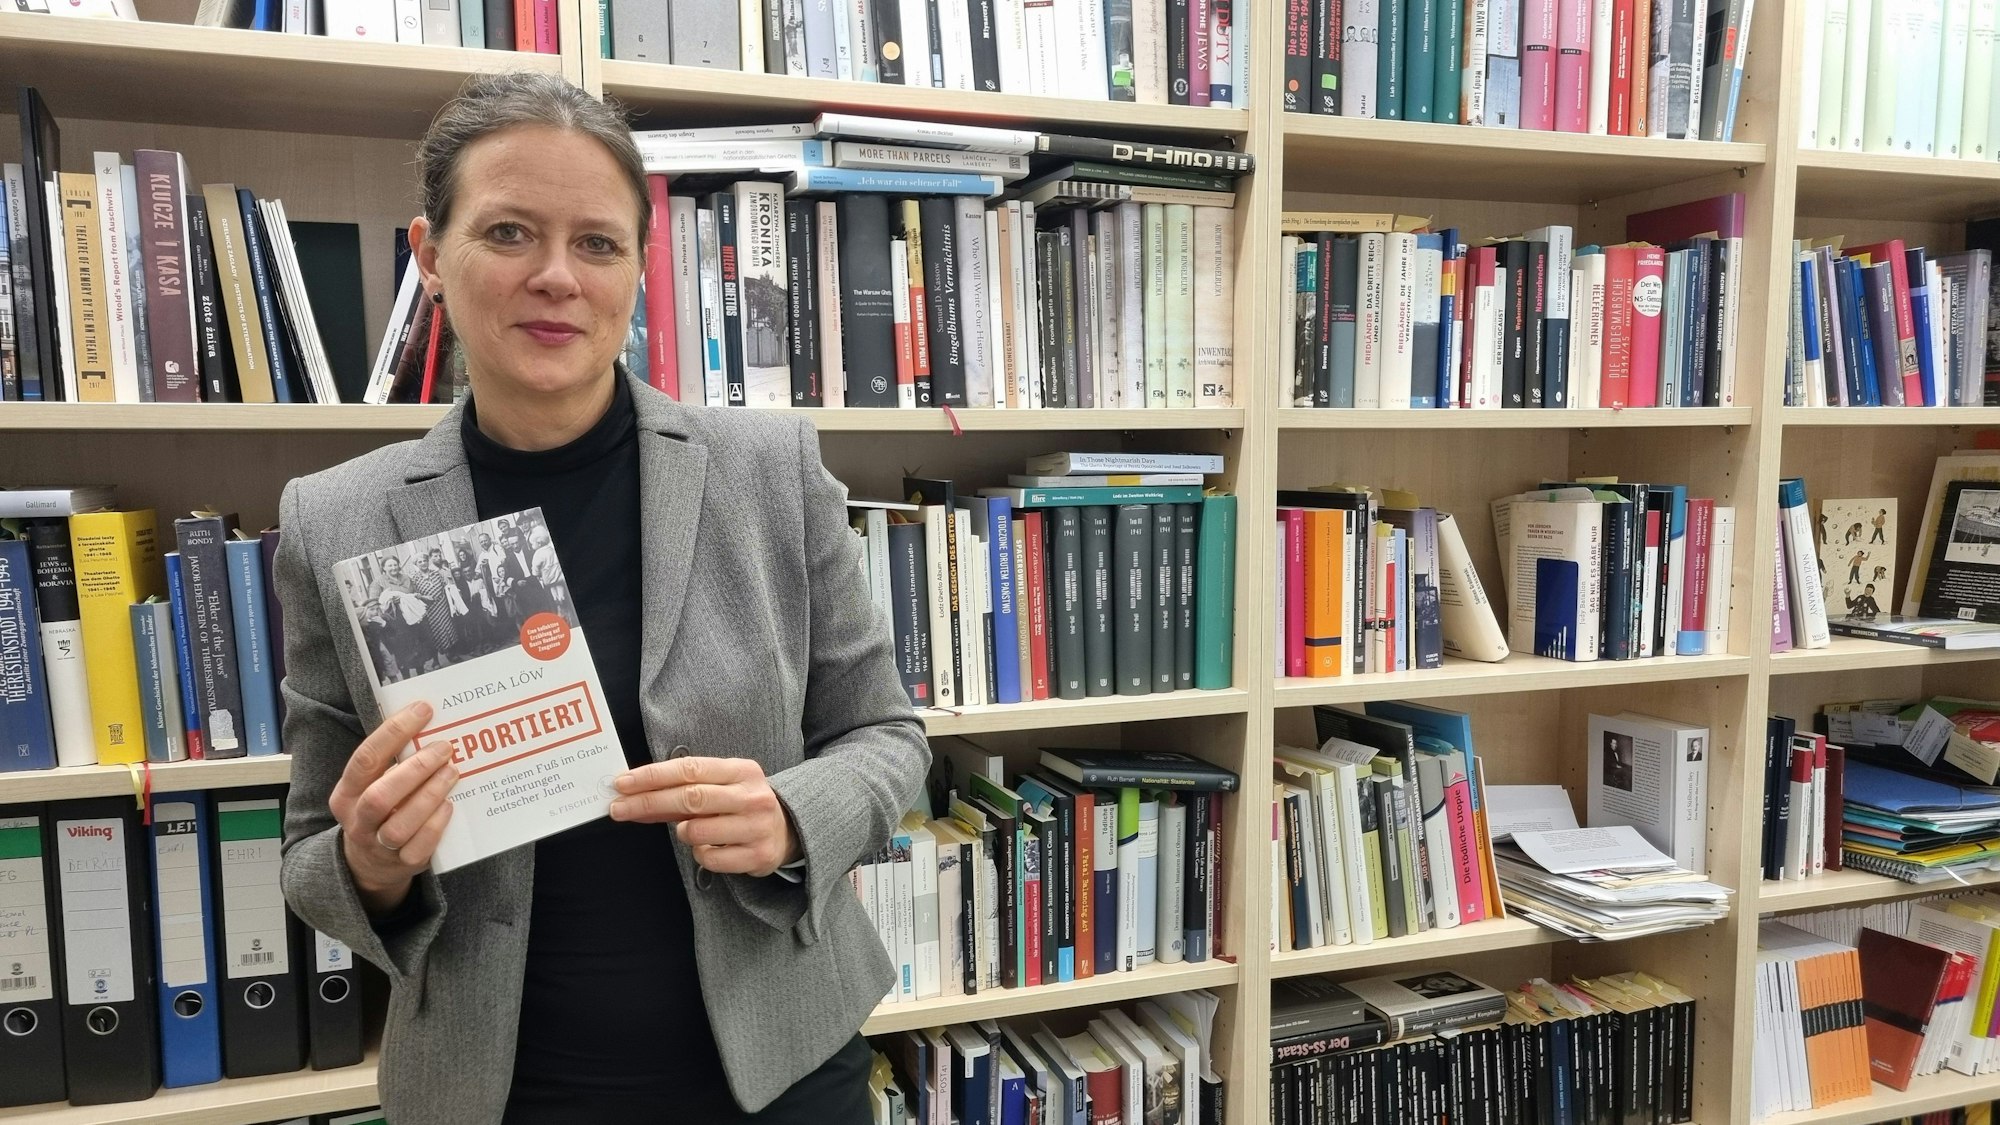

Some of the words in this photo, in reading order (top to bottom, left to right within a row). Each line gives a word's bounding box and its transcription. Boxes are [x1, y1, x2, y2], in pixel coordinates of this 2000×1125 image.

[1195, 31, 1208, 70] JEWS
[1287, 39, 1297, 55] Die
[1299, 19, 1308, 56] UdSSR«
[1693, 75, 1701, 104] Notizen
[859, 148, 884, 159] MORE
[886, 149, 911, 161] THAN
[913, 153, 951, 164] PARCELS
[910, 178, 941, 187] seltener
[105, 188, 116, 233] Auschwitz
[149, 173, 175, 230] KLUCZE
[749, 191, 758, 243] ZAMORDOWANEGO
[759, 191, 772, 268] KRONIKA
[75, 225, 87, 249] THEATRE
[110, 235, 118, 255] from
[971, 237, 979, 255] Who
[112, 257, 122, 286] Report
[722, 245, 736, 280] HITLER'S
[792, 257, 800, 280] JEWISH
[941, 224, 954, 294] Vermächtnis
[973, 259, 981, 275] Will
[79, 267, 90, 288] MEMORY
[156, 256, 181, 297] KASA
[932, 262, 941, 292] Kassow
[113, 288, 124, 322] Witold's
[221, 218, 232, 249] DZIELNICE
[234, 283, 245, 313] DISTRICTS
[241, 323, 255, 370] EXTERMINATION
[724, 282, 738, 316] GHETTOS
[793, 282, 801, 318] CHILDHOOD
[915, 294, 925, 321] WARSAW
[973, 280, 982, 307] Write
[201, 295, 215, 323] złote
[935, 306, 944, 333] Samuel
[975, 310, 984, 328] Our
[1590, 284, 1600, 346] HELFERINNEN
[1611, 278, 1624, 355] TODESMÄRSCHE
[206, 326, 217, 357] żniwa
[794, 327, 804, 355] KRAKÓW
[917, 322, 926, 346] GHETTO
[946, 298, 959, 366] Ringelblums
[1364, 313, 1372, 365] FRIEDLÄNDER
[1398, 301, 1406, 354] FRIEDLÄNDER
[85, 336, 97, 363] THEATRE
[919, 348, 927, 368] POLICE
[976, 330, 986, 368] History?
[1609, 362, 1621, 378] DIE
[25, 501, 57, 509] Gallimard
[948, 514, 956, 544] GETTOS
[996, 515, 1010, 550] OTOCZONE
[949, 546, 957, 560] DES
[998, 552, 1011, 579] DRUTEM
[1016, 539, 1025, 596] SPACEROWNIK
[188, 556, 202, 582] JAKOB
[907, 543, 918, 597] Litzmannstadt«
[950, 561, 959, 596] GESICHT
[1590, 568, 1596, 578] ES
[1775, 550, 1784, 589] DRITTEN
[194, 583, 207, 629] EDELSTEIN
[208, 590, 221, 621] “Elder
[951, 597, 959, 612] DAS
[1000, 581, 1013, 614] PAŃSTWO
[1777, 590, 1785, 611] ZUM
[13, 588, 27, 648] Zwangsgemeinschaft
[146, 614, 156, 634] Länder
[212, 624, 222, 634] of
[910, 598, 922, 660] »Gettoverwaltung
[1773, 614, 1781, 633] DAS
[148, 635, 158, 669] böhmischen
[200, 631, 209, 644] OF
[214, 637, 224, 651] the
[0, 616, 27, 704] THERESIENSTADT
[23, 664, 31, 683] Antlitz
[153, 680, 163, 710] Geschichte
[441, 682, 508, 710] ANDREA
[510, 667, 546, 691] LÖW
[155, 711, 164, 729] Kleine
[260, 723, 268, 747] HANSER
[449, 699, 584, 764] EPORTIERT
[1407, 734, 1416, 766] NS-STAAT
[479, 780, 498, 792] mit
[501, 769, 535, 786] einem
[536, 759, 559, 775] Fuß
[560, 755, 575, 766] im
[577, 744, 608, 759] Grab«
[486, 792, 540, 817] deutscher
[543, 780, 575, 798] Juden
[492, 773, 561, 802] Erfahrungen
[559, 795, 599, 814] FISCHER
[1412, 777, 1425, 840] PROPAGANDAFILM
[1453, 789, 1465, 823] Utopie
[67, 826, 112, 841] Viking
[1458, 826, 1471, 866] tödliche
[1462, 868, 1472, 884] Die
[1278, 1038, 1325, 1057] SS-Staat
[1327, 1036, 1350, 1050] Der
